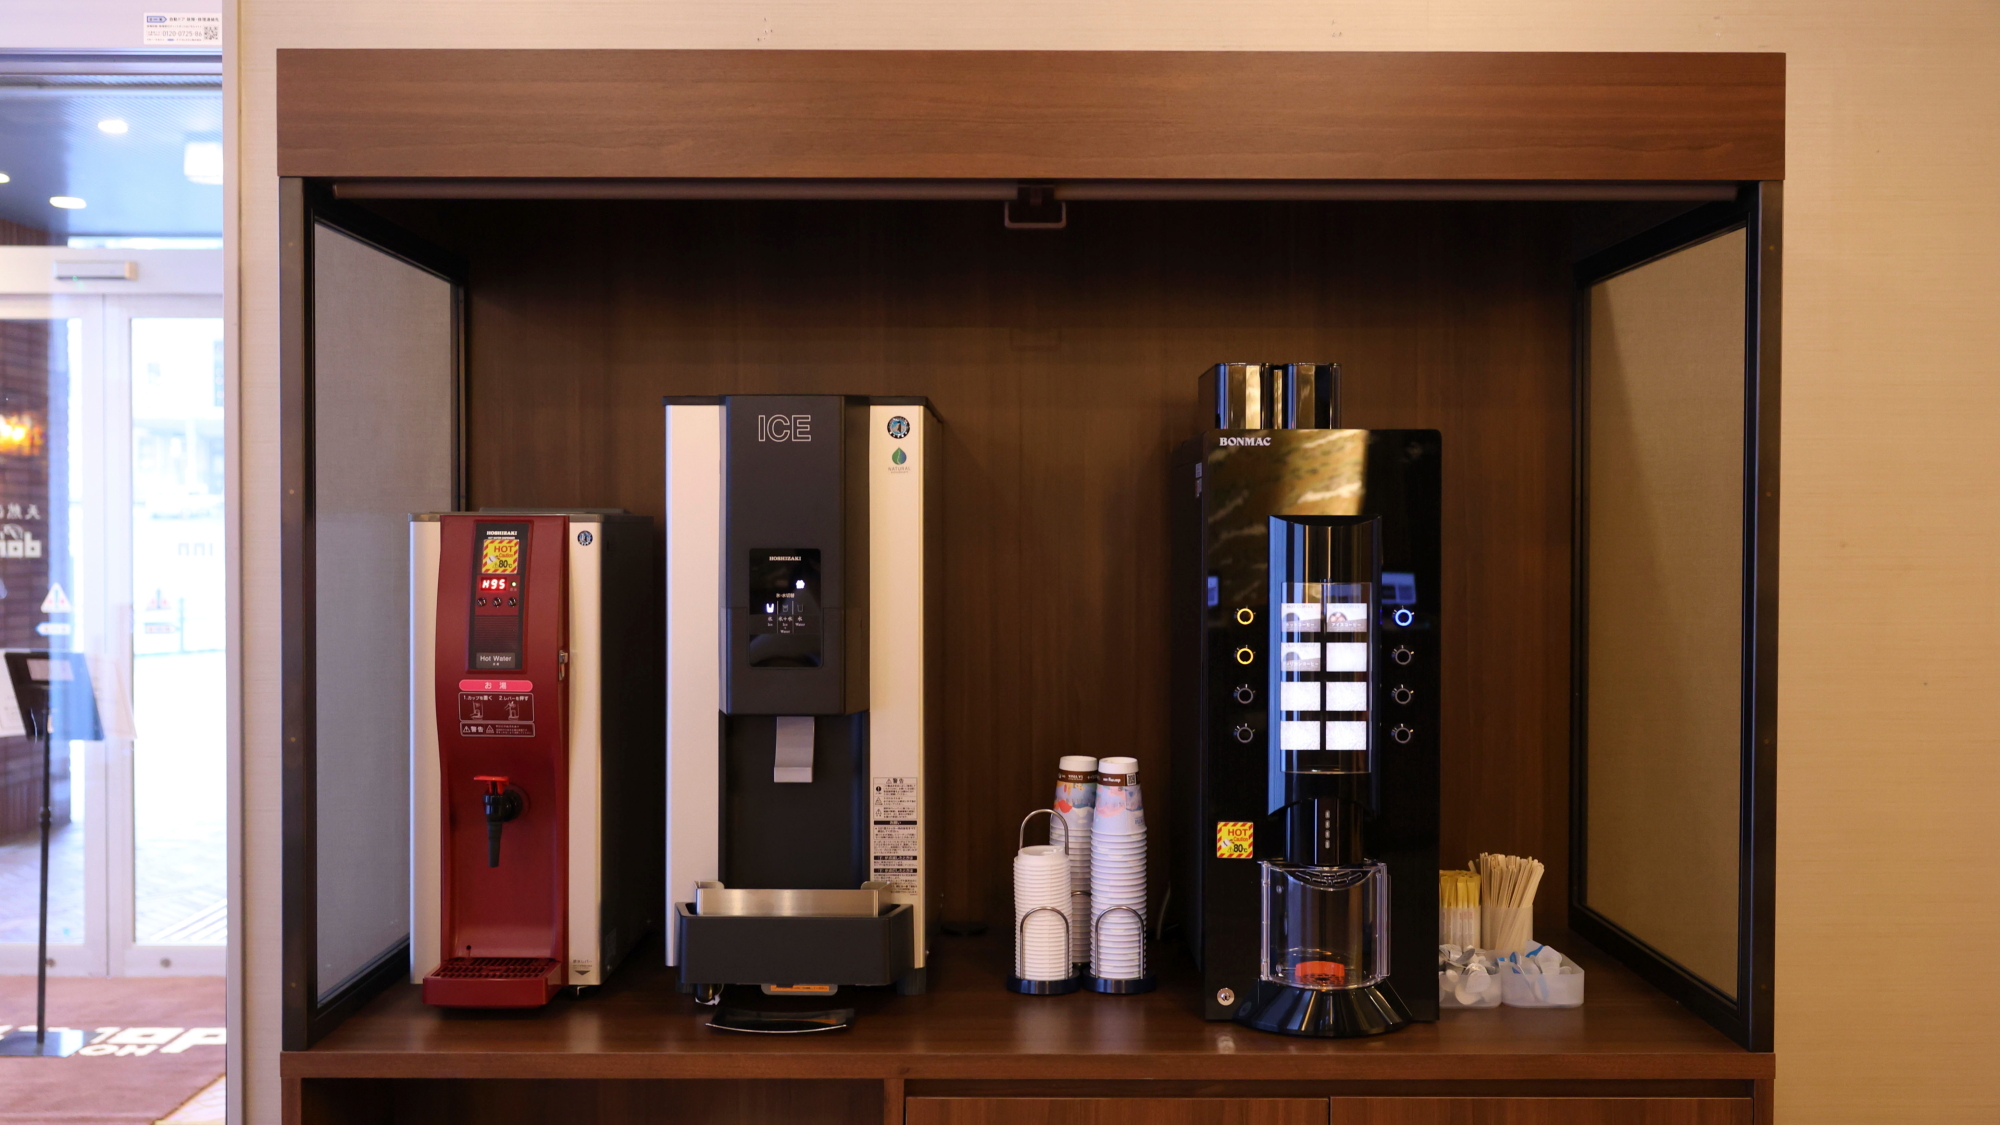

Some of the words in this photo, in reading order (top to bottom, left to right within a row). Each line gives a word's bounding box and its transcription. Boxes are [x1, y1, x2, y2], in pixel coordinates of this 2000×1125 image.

[758, 414, 812, 442] ICE
[1219, 436, 1271, 447] BONMAC
[493, 545, 514, 553] HOT
[1228, 828, 1248, 836] HOT
